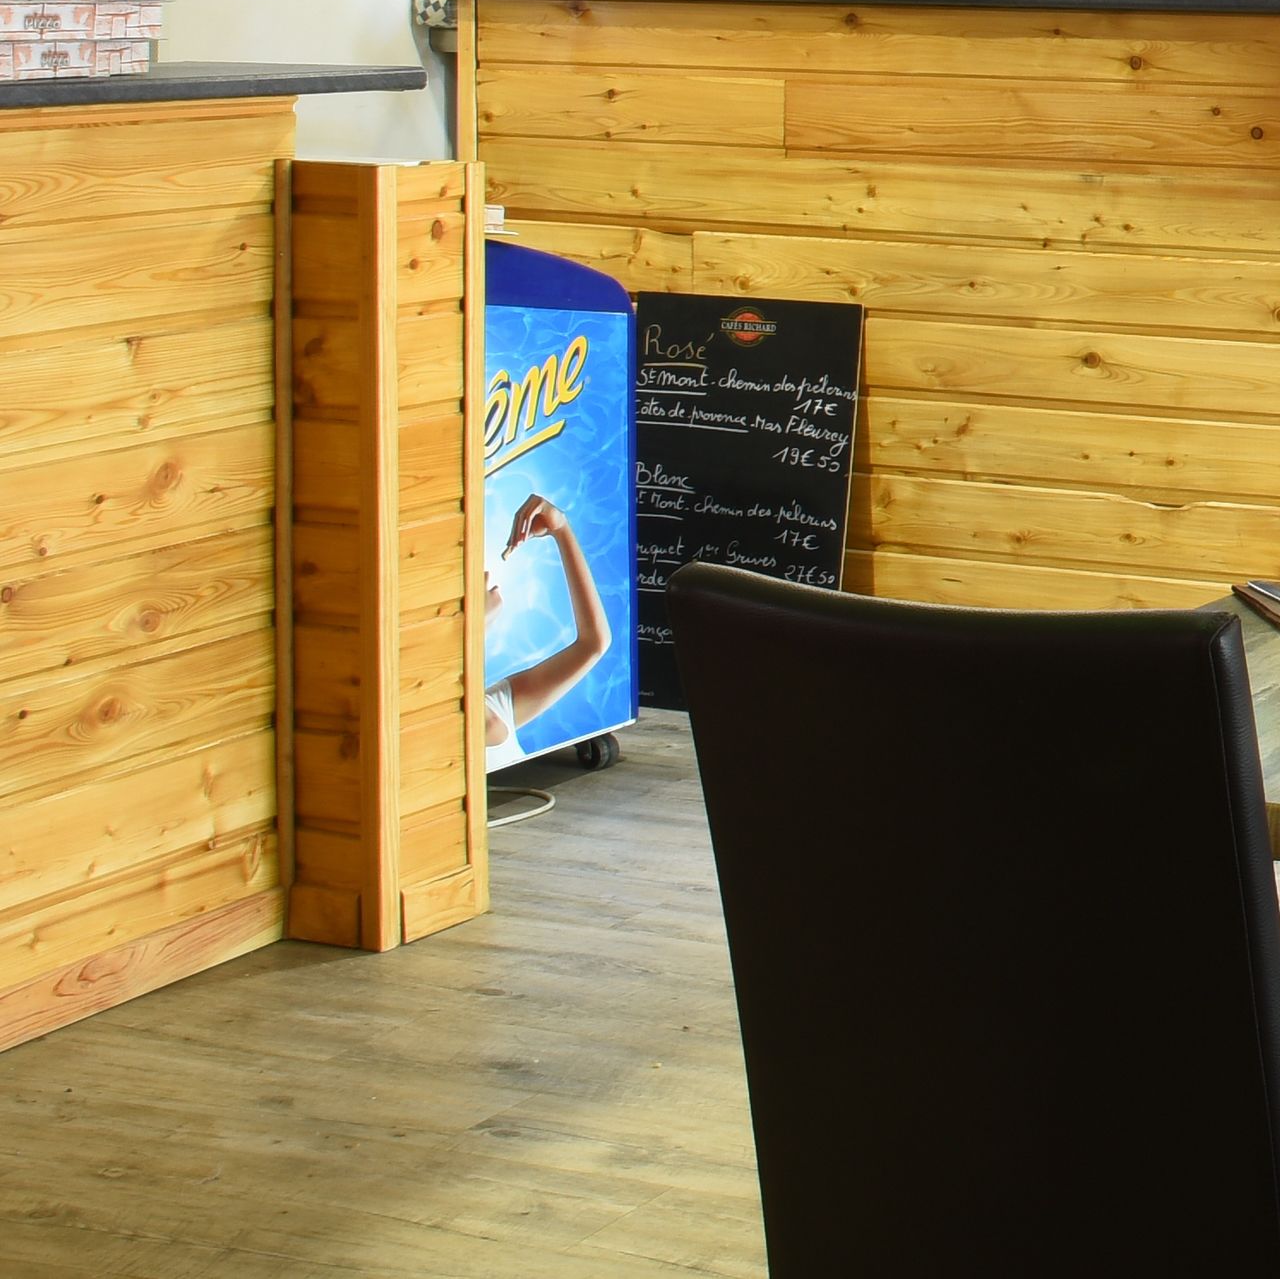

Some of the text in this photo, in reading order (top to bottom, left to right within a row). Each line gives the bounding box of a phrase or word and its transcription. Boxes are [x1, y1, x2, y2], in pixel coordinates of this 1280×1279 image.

[743, 322, 777, 332] RICHARD
[644, 323, 715, 360] Rosé
[717, 368, 771, 391] chemin
[773, 375, 796, 392] des
[668, 403, 685, 417] de
[793, 398, 838, 417] 17€
[636, 461, 694, 490] Blanc
[694, 495, 743, 517] chemin
[747, 503, 772, 517] des
[774, 529, 819, 551] 17€
